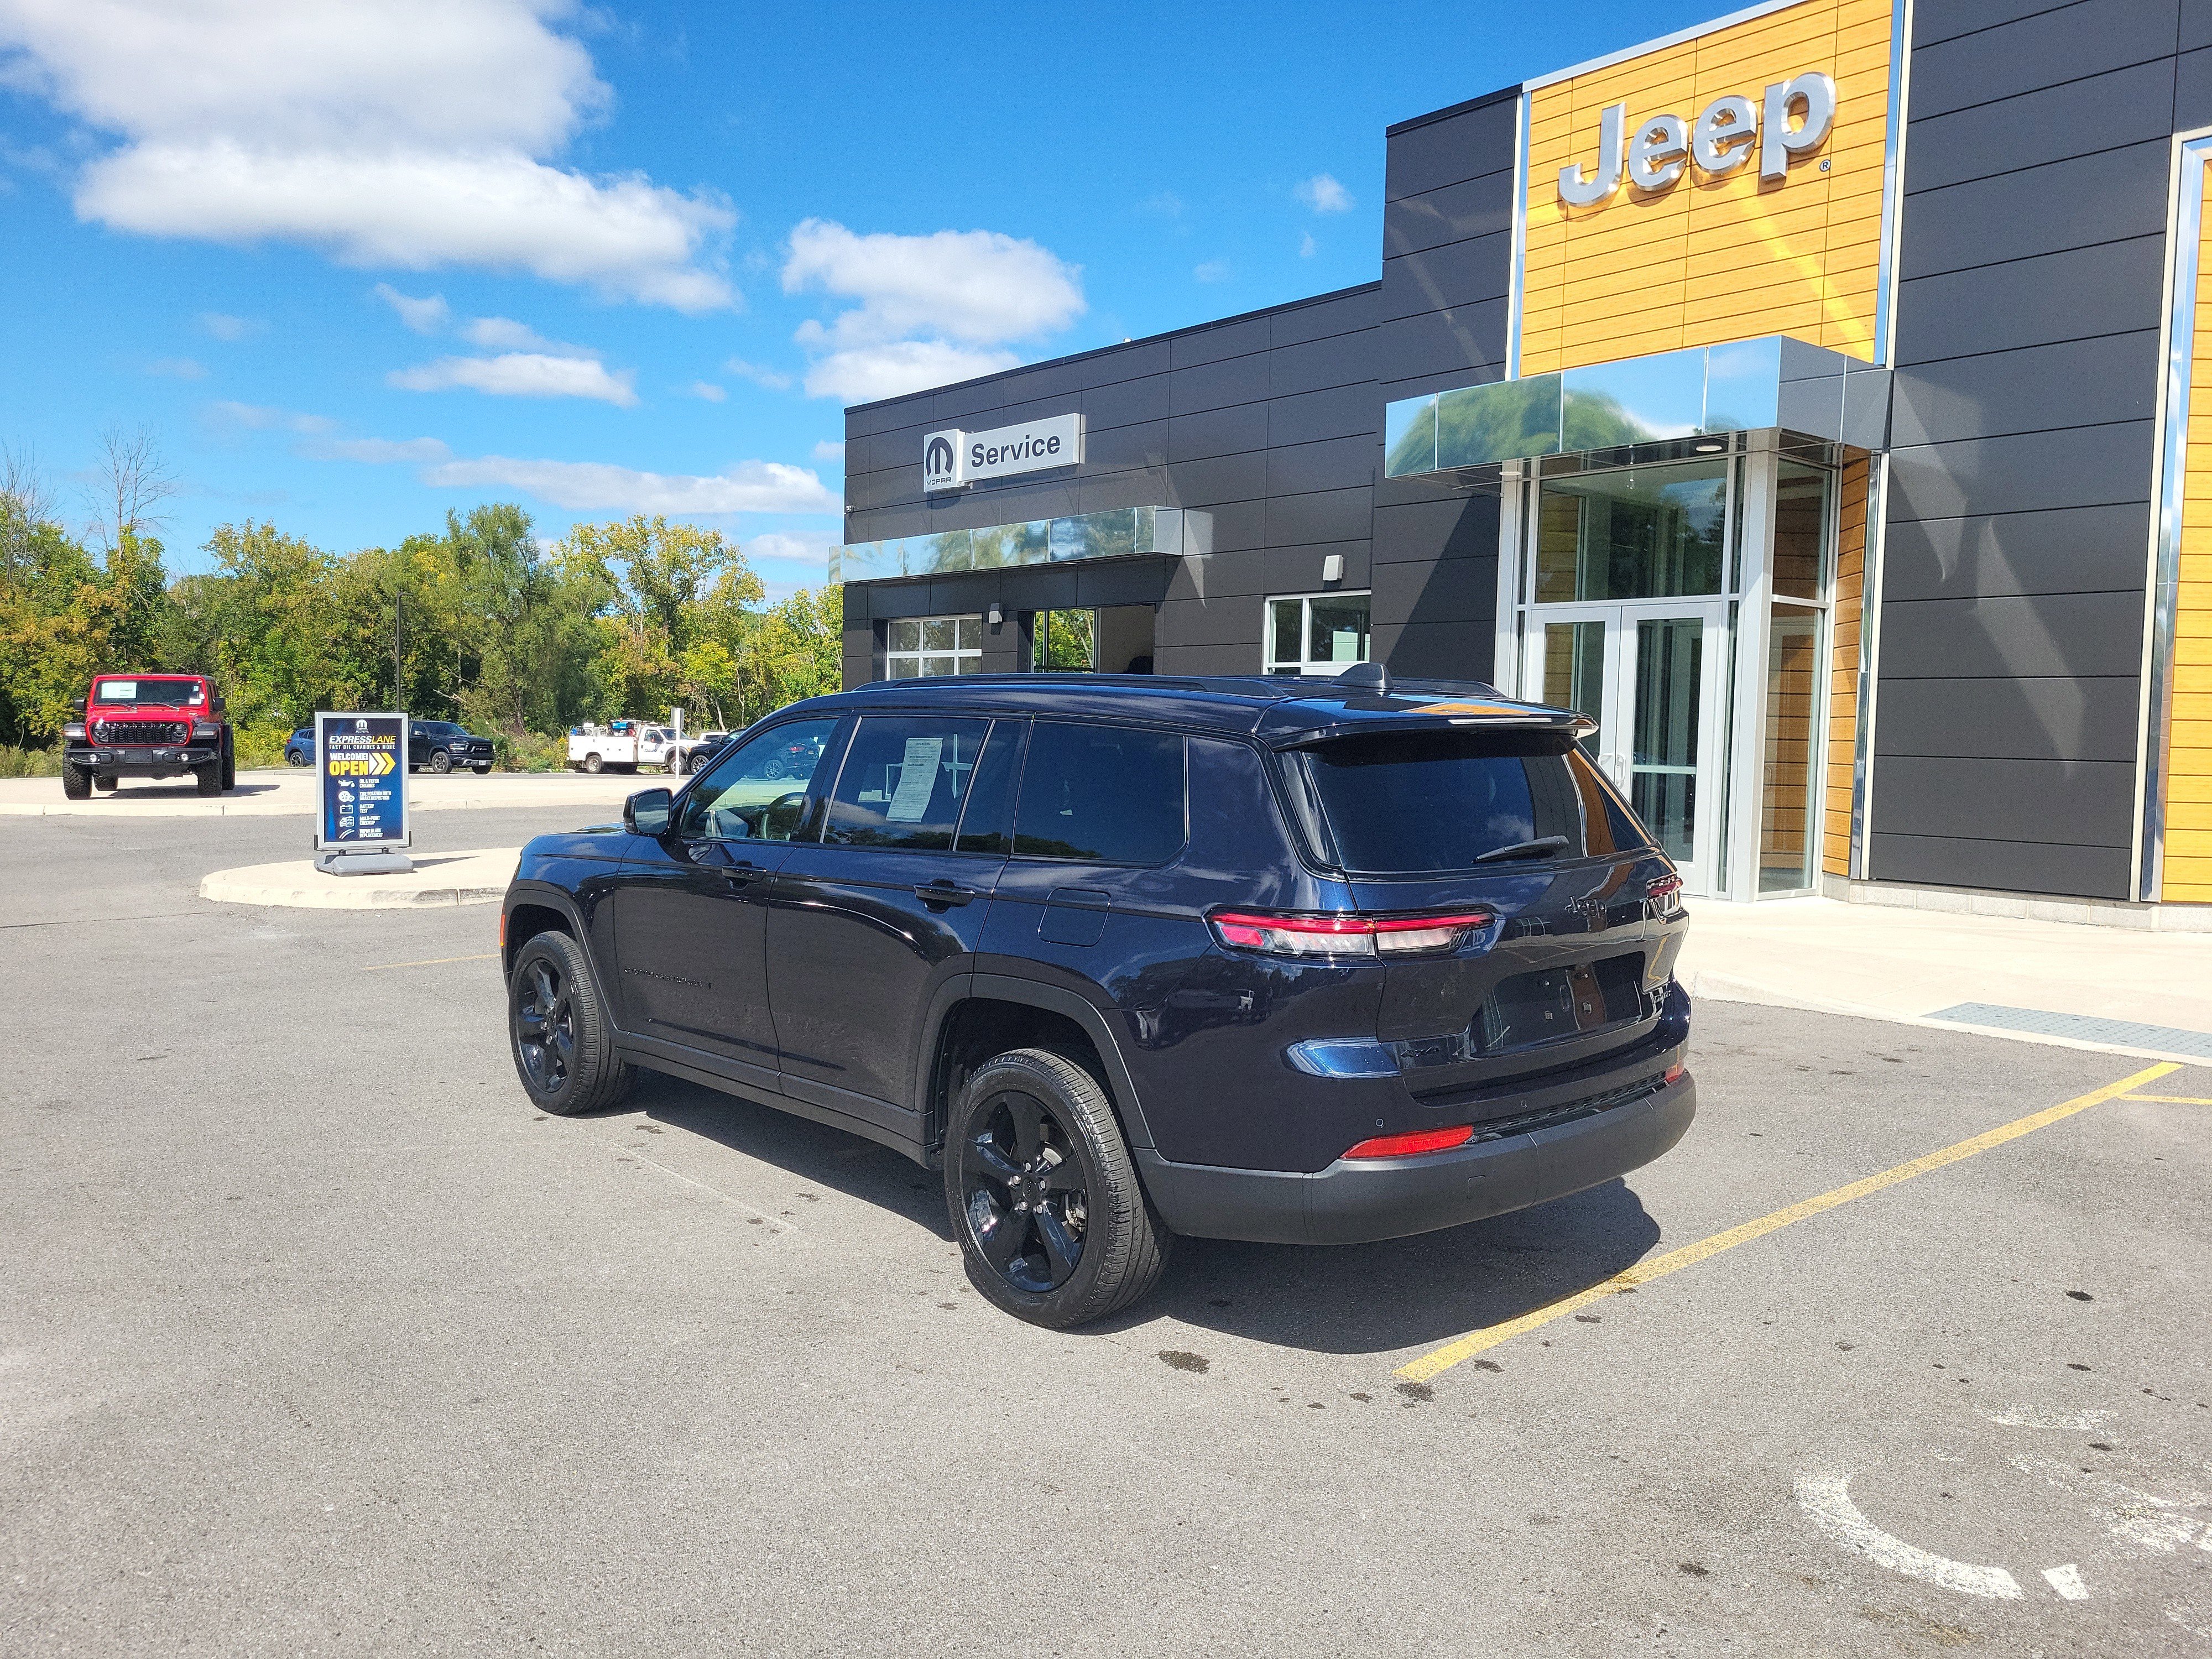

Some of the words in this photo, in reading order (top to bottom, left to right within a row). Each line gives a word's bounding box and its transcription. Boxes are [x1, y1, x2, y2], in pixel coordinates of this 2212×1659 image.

[1558, 71, 1837, 208] Jeep
[971, 434, 1061, 468] Service
[926, 477, 952, 487] MOPAR
[330, 753, 368, 761] WELCOME!
[330, 760, 368, 776] OPEN
